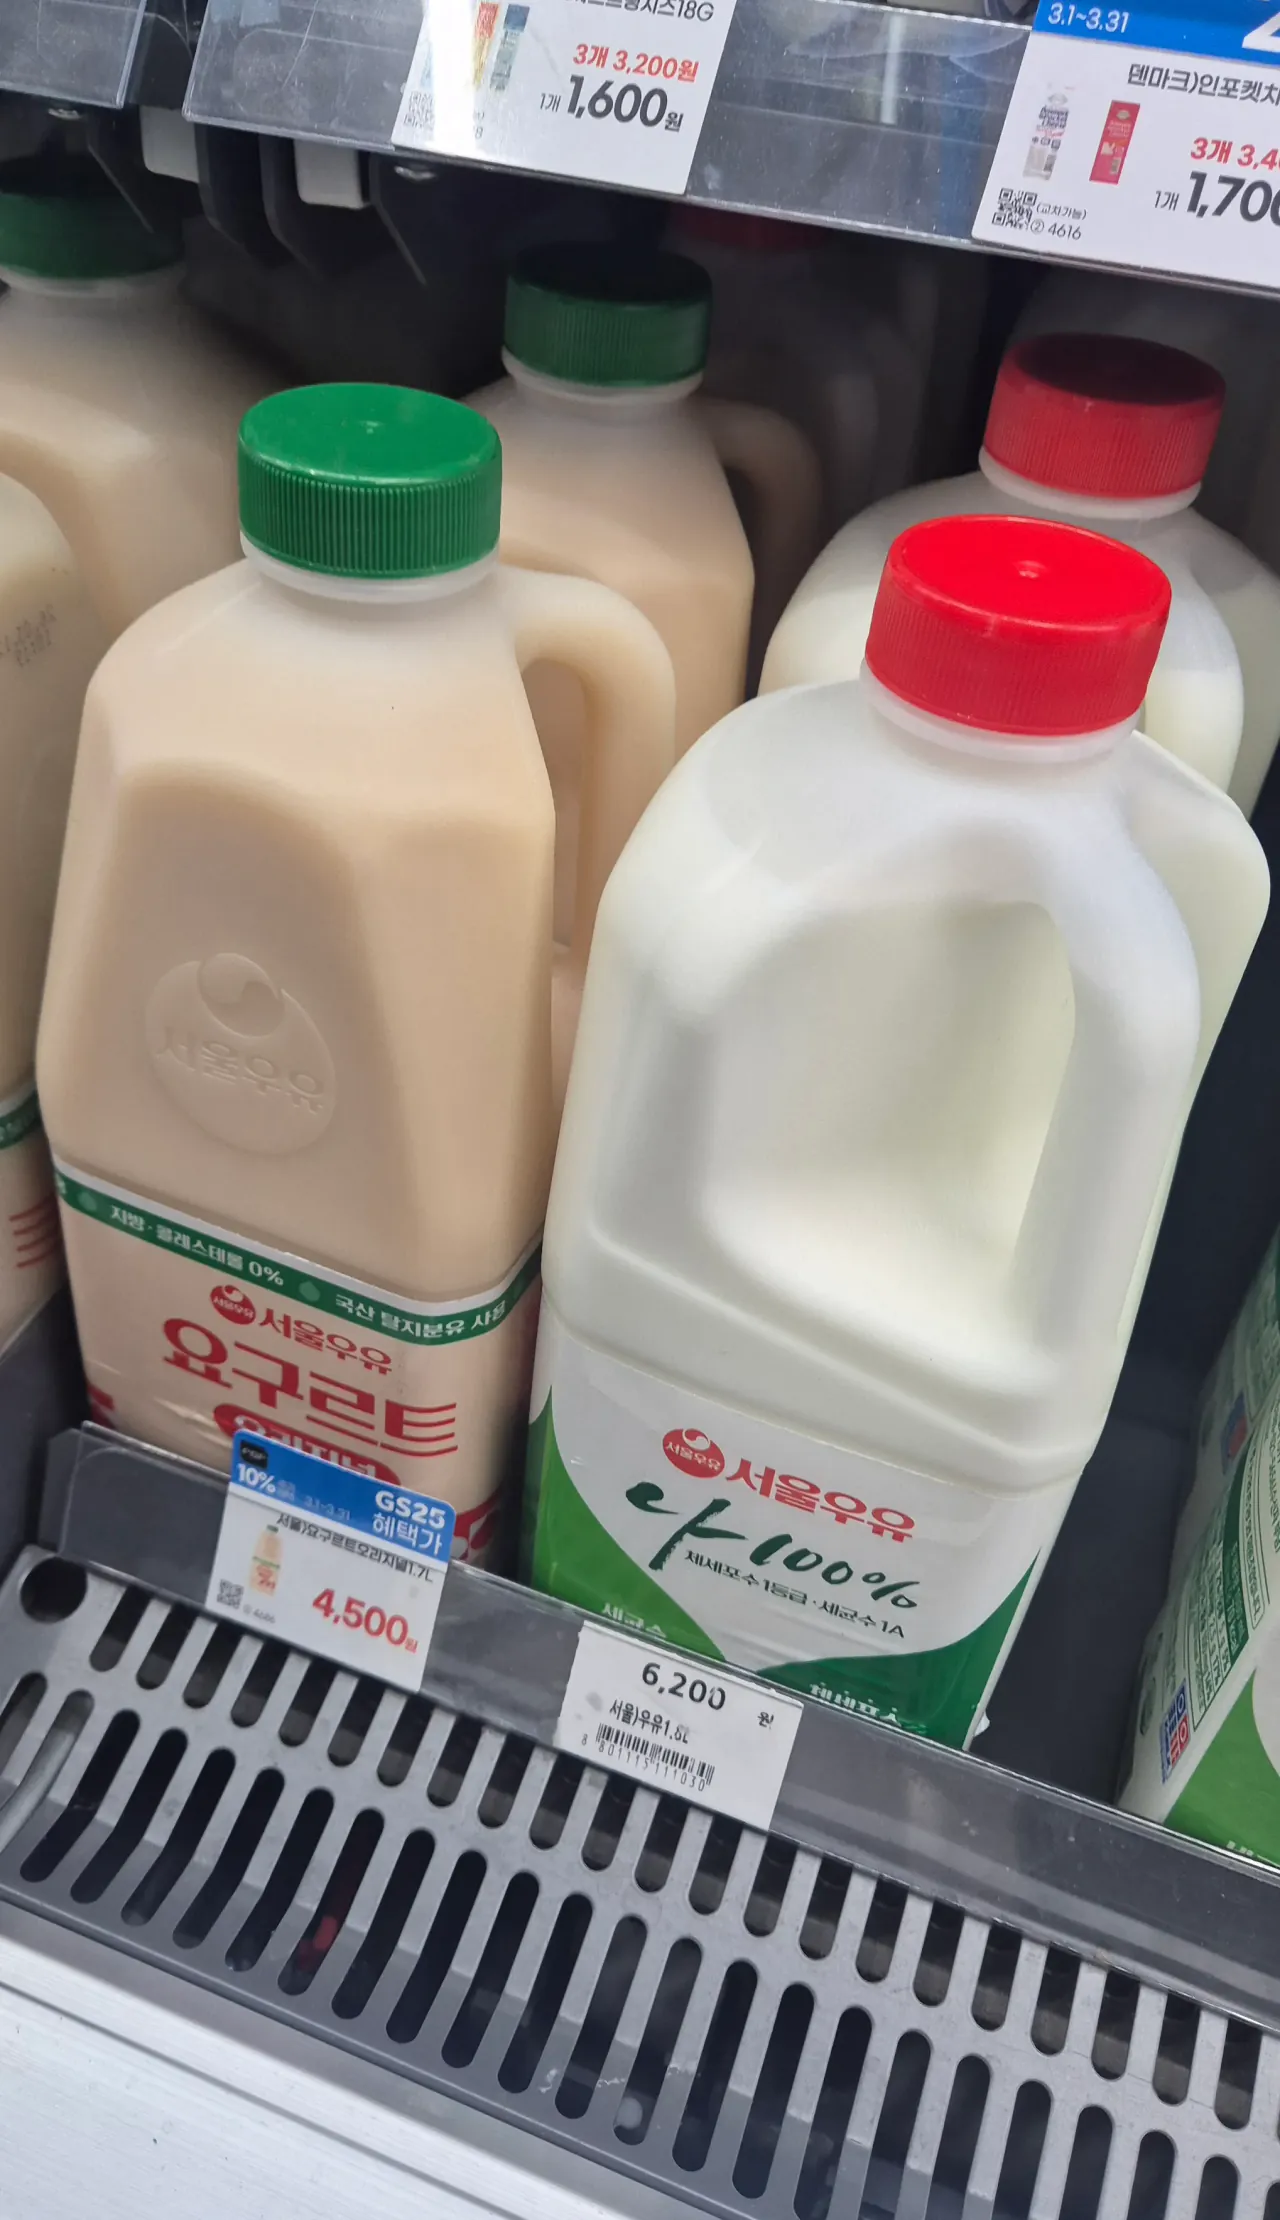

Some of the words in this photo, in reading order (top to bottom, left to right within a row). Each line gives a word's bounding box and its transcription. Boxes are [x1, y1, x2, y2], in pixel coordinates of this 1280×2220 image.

[1047, 2, 1131, 34] 3.1~3.31
[572, 43, 610, 69] 3개
[612, 49, 700, 83] 3,200원
[540, 92, 562, 113] 1개
[1190, 136, 1233, 165] 3개
[1237, 143, 1280, 171] 3,4
[1154, 190, 1180, 211] 1개
[1047, 222, 1082, 241] 4616
[153, 1026, 326, 1116] 서울우유
[248, 1259, 284, 1287] 0%
[335, 1294, 376, 1322] 국산
[380, 1309, 466, 1339] 탈지분유
[258, 1307, 393, 1376] 서울우유
[162, 1317, 459, 1457] 요구르트
[665, 1440, 723, 1472] 서울우유
[235, 1462, 277, 1494] 10%
[374, 1489, 447, 1530] GS25
[725, 1457, 916, 1544] 서울우유
[371, 1510, 444, 1557] 혜택가
[641, 1661, 727, 1711] 6,200
[756, 1710, 775, 1730] 원
